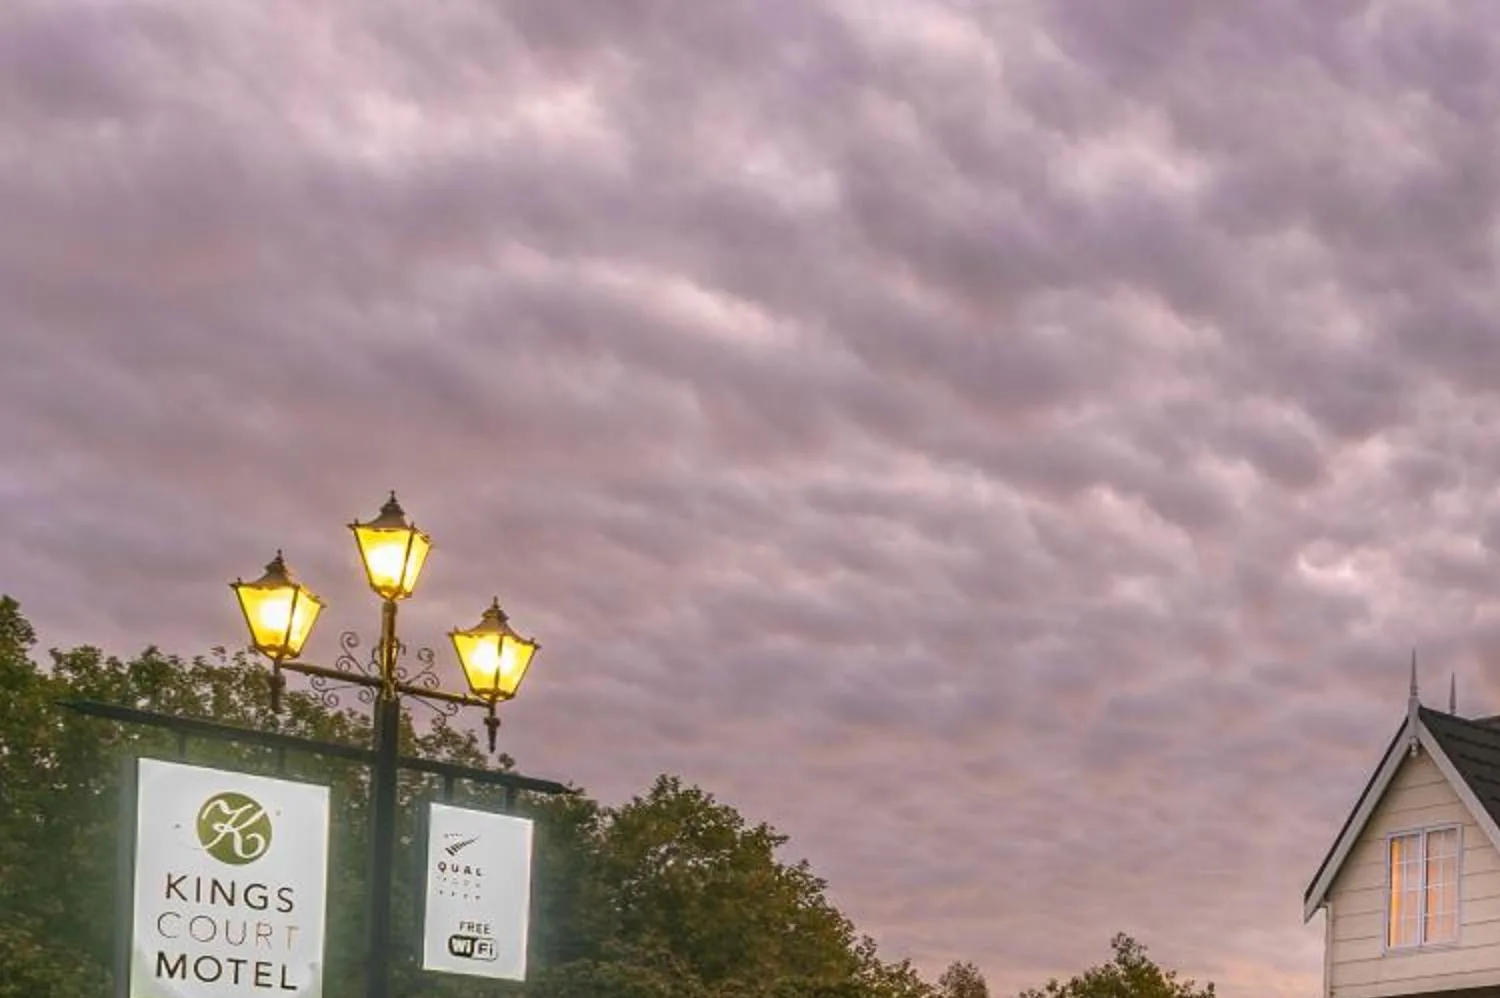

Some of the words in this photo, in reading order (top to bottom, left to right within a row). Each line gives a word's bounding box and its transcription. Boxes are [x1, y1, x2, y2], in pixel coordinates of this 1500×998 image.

[164, 873, 294, 913] KINGS
[157, 911, 300, 951] COURT
[459, 921, 491, 935] FREE
[155, 951, 298, 991] MOTEL
